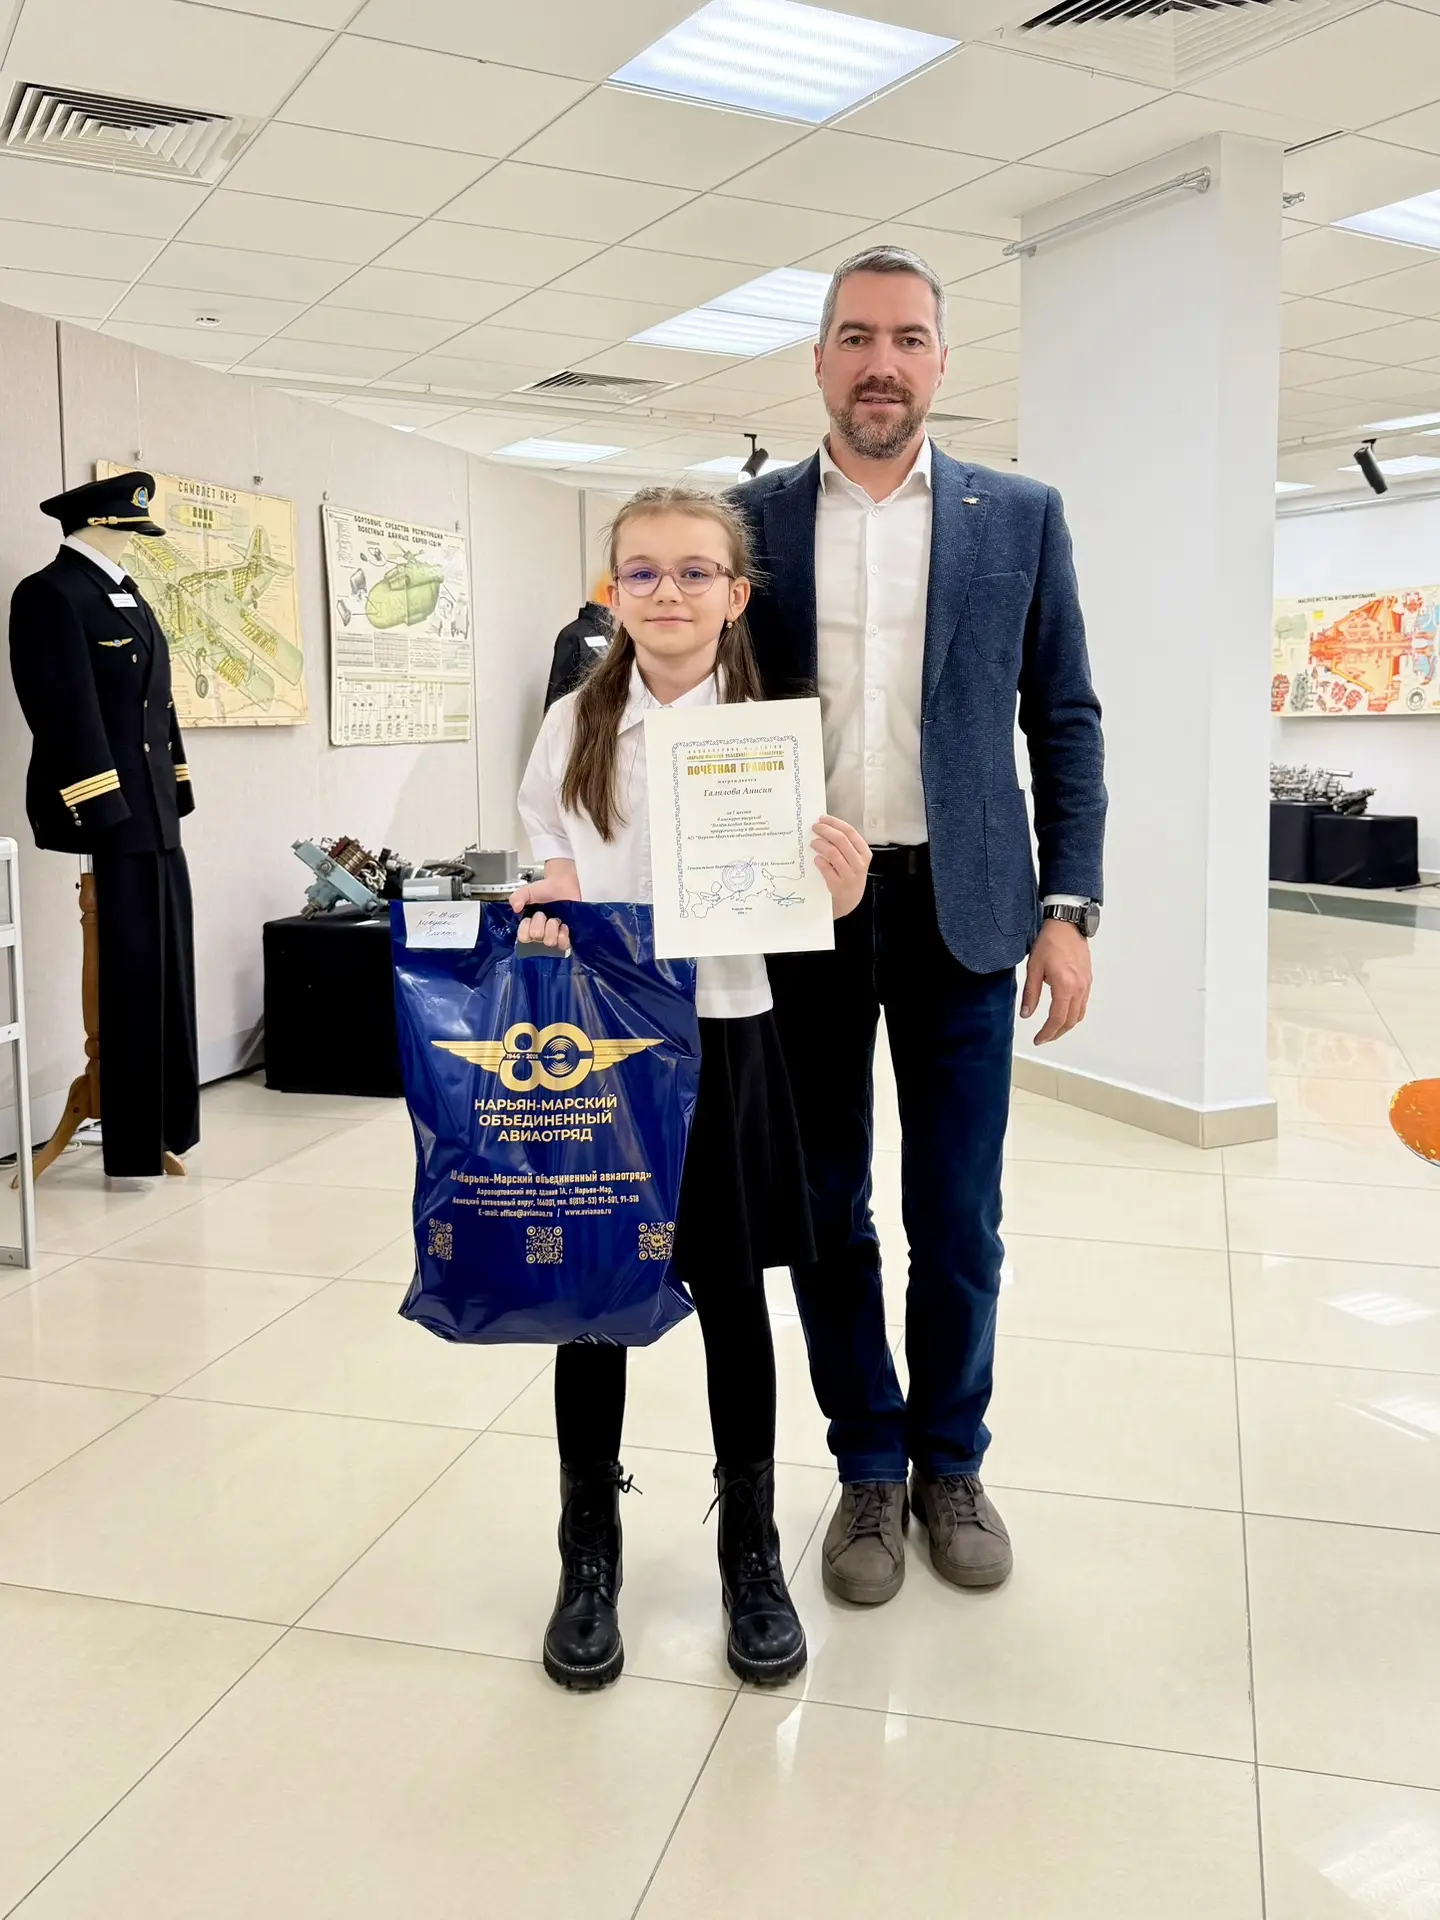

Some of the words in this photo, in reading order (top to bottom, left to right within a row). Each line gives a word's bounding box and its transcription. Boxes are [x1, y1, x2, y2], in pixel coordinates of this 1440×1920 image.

[178, 481, 216, 499] САМОЛЕТ
[220, 489, 237, 503] АН-2
[354, 515, 382, 527] БОРТОВЫЕ
[385, 522, 410, 533] СРЕДСТВА
[412, 527, 444, 540] РЕГИСТРАЦИИ
[357, 525, 385, 537] ПОЛЕТНЫХ
[388, 531, 410, 542] ДАННЫХ
[687, 763, 737, 776] ПОЧЁТНАЯ
[741, 760, 785, 773] ГРАМОТА
[743, 787, 773, 795] Анисия
[499, 1022, 594, 1092] 80
[474, 1094, 618, 1111] НАРЬЯН-МАРСКИЙ
[479, 1112, 612, 1127] ОБЪЕДИНЕННЫЙ
[497, 1127, 593, 1142] АВИАОТРЯД
[535, 1170, 598, 1185] объединенный
[600, 1171, 652, 1182] авиаотряд»
[476, 1187, 524, 1197] Аэропортовский
[575, 1185, 613, 1195] Нарьян-Мар,
[481, 1198, 516, 1206] автономный
[500, 1209, 553, 1218] office@avianao.ru
[564, 1208, 612, 1216] www.avianao.ru
